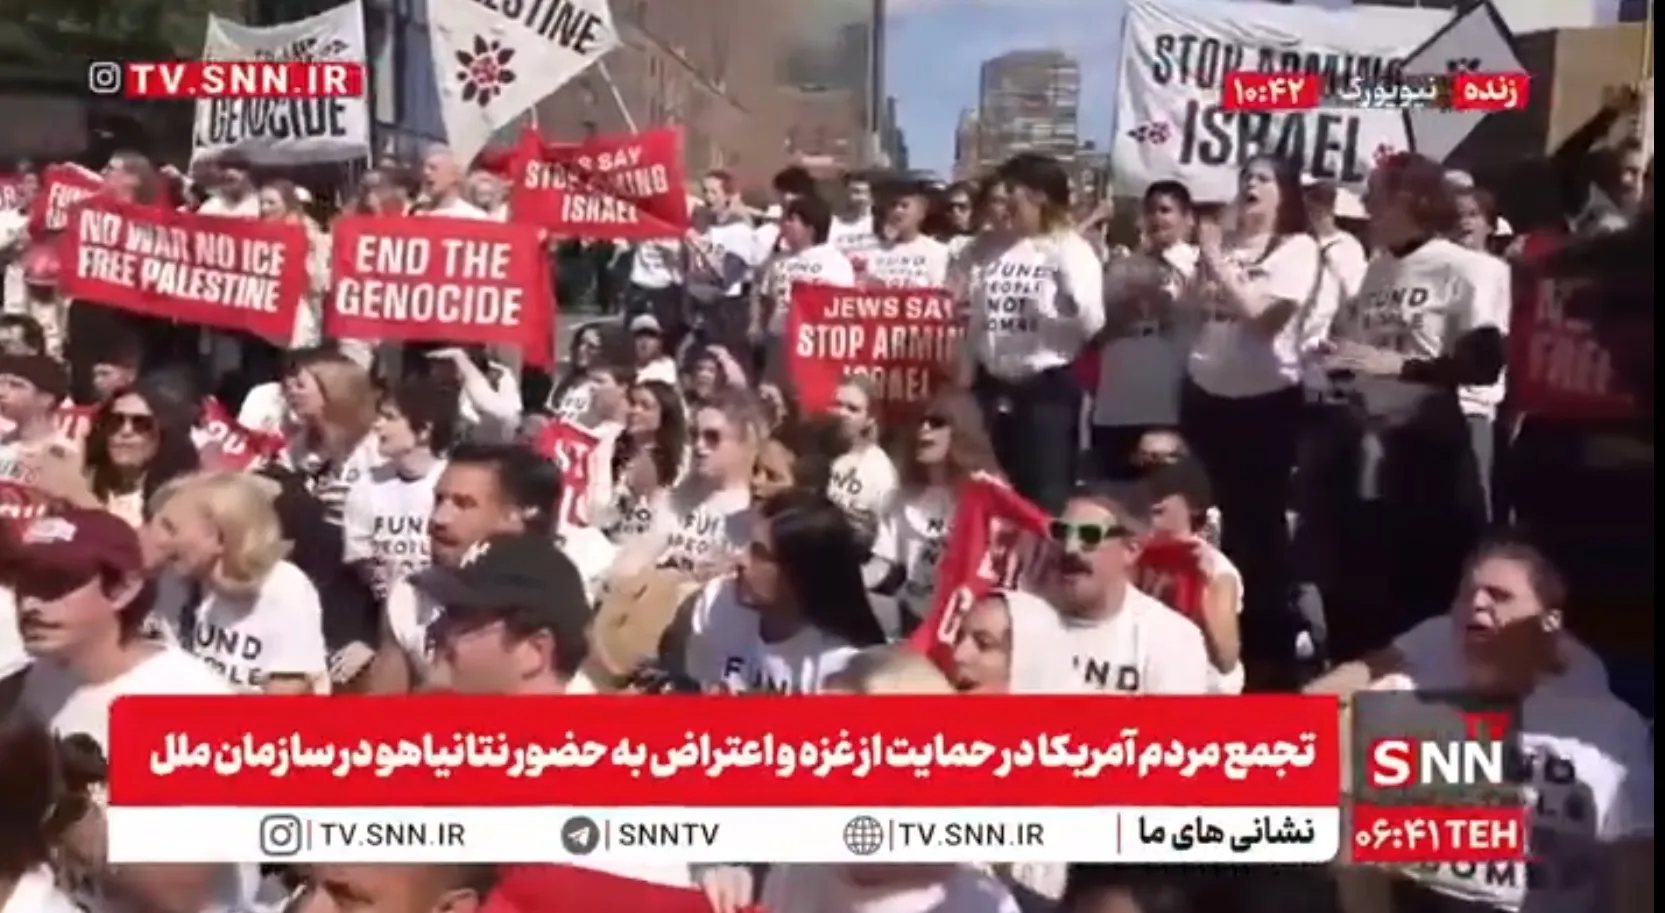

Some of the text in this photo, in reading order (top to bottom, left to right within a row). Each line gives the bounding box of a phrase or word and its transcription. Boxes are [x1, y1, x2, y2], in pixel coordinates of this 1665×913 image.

[597, 146, 642, 172] SAY
[561, 193, 638, 224] ISRAEL
[79, 208, 122, 246] NO
[126, 220, 190, 262] WAR
[193, 231, 237, 269] NO
[242, 239, 287, 277] ICE
[355, 235, 512, 280] END THE
[77, 246, 282, 313] FREE PALESTINE
[335, 278, 523, 326] GENOCIDE
[823, 297, 899, 319] JEWS
[797, 324, 865, 361] STOP
[374, 515, 423, 536] FUN
[197, 621, 263, 660] UND
